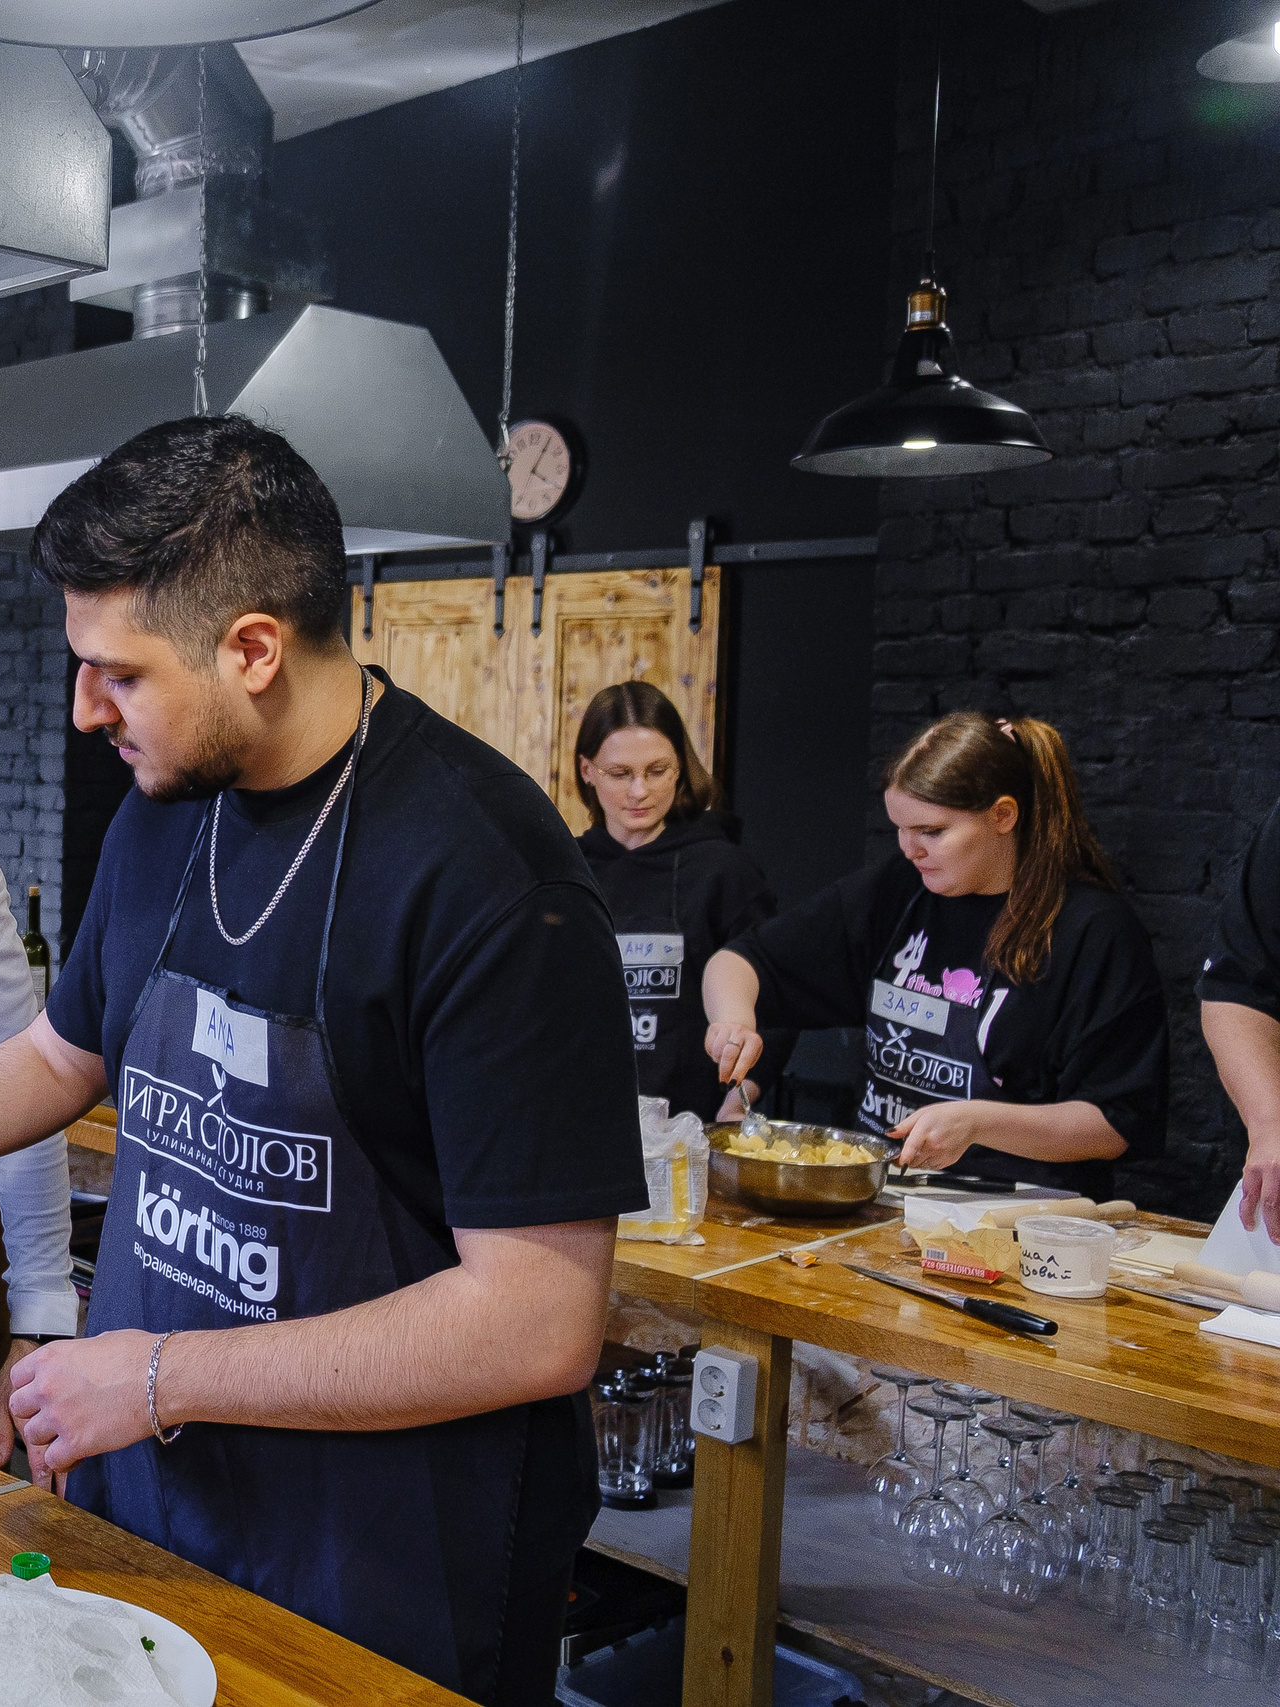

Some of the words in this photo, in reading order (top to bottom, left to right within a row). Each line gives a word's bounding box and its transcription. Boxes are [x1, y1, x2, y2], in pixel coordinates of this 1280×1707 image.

[624, 968, 676, 987] ОЛОВ
[883, 990, 919, 1017] ЗАЯ
[880, 1046, 965, 1088] СТОЛОВ
[128, 1077, 193, 1141] ИГРА
[200, 1112, 318, 1182] СТОЛОВ
[136, 1170, 279, 1302] körting
[239, 1222, 267, 1240] 1889
[214, 1288, 277, 1321] техника
